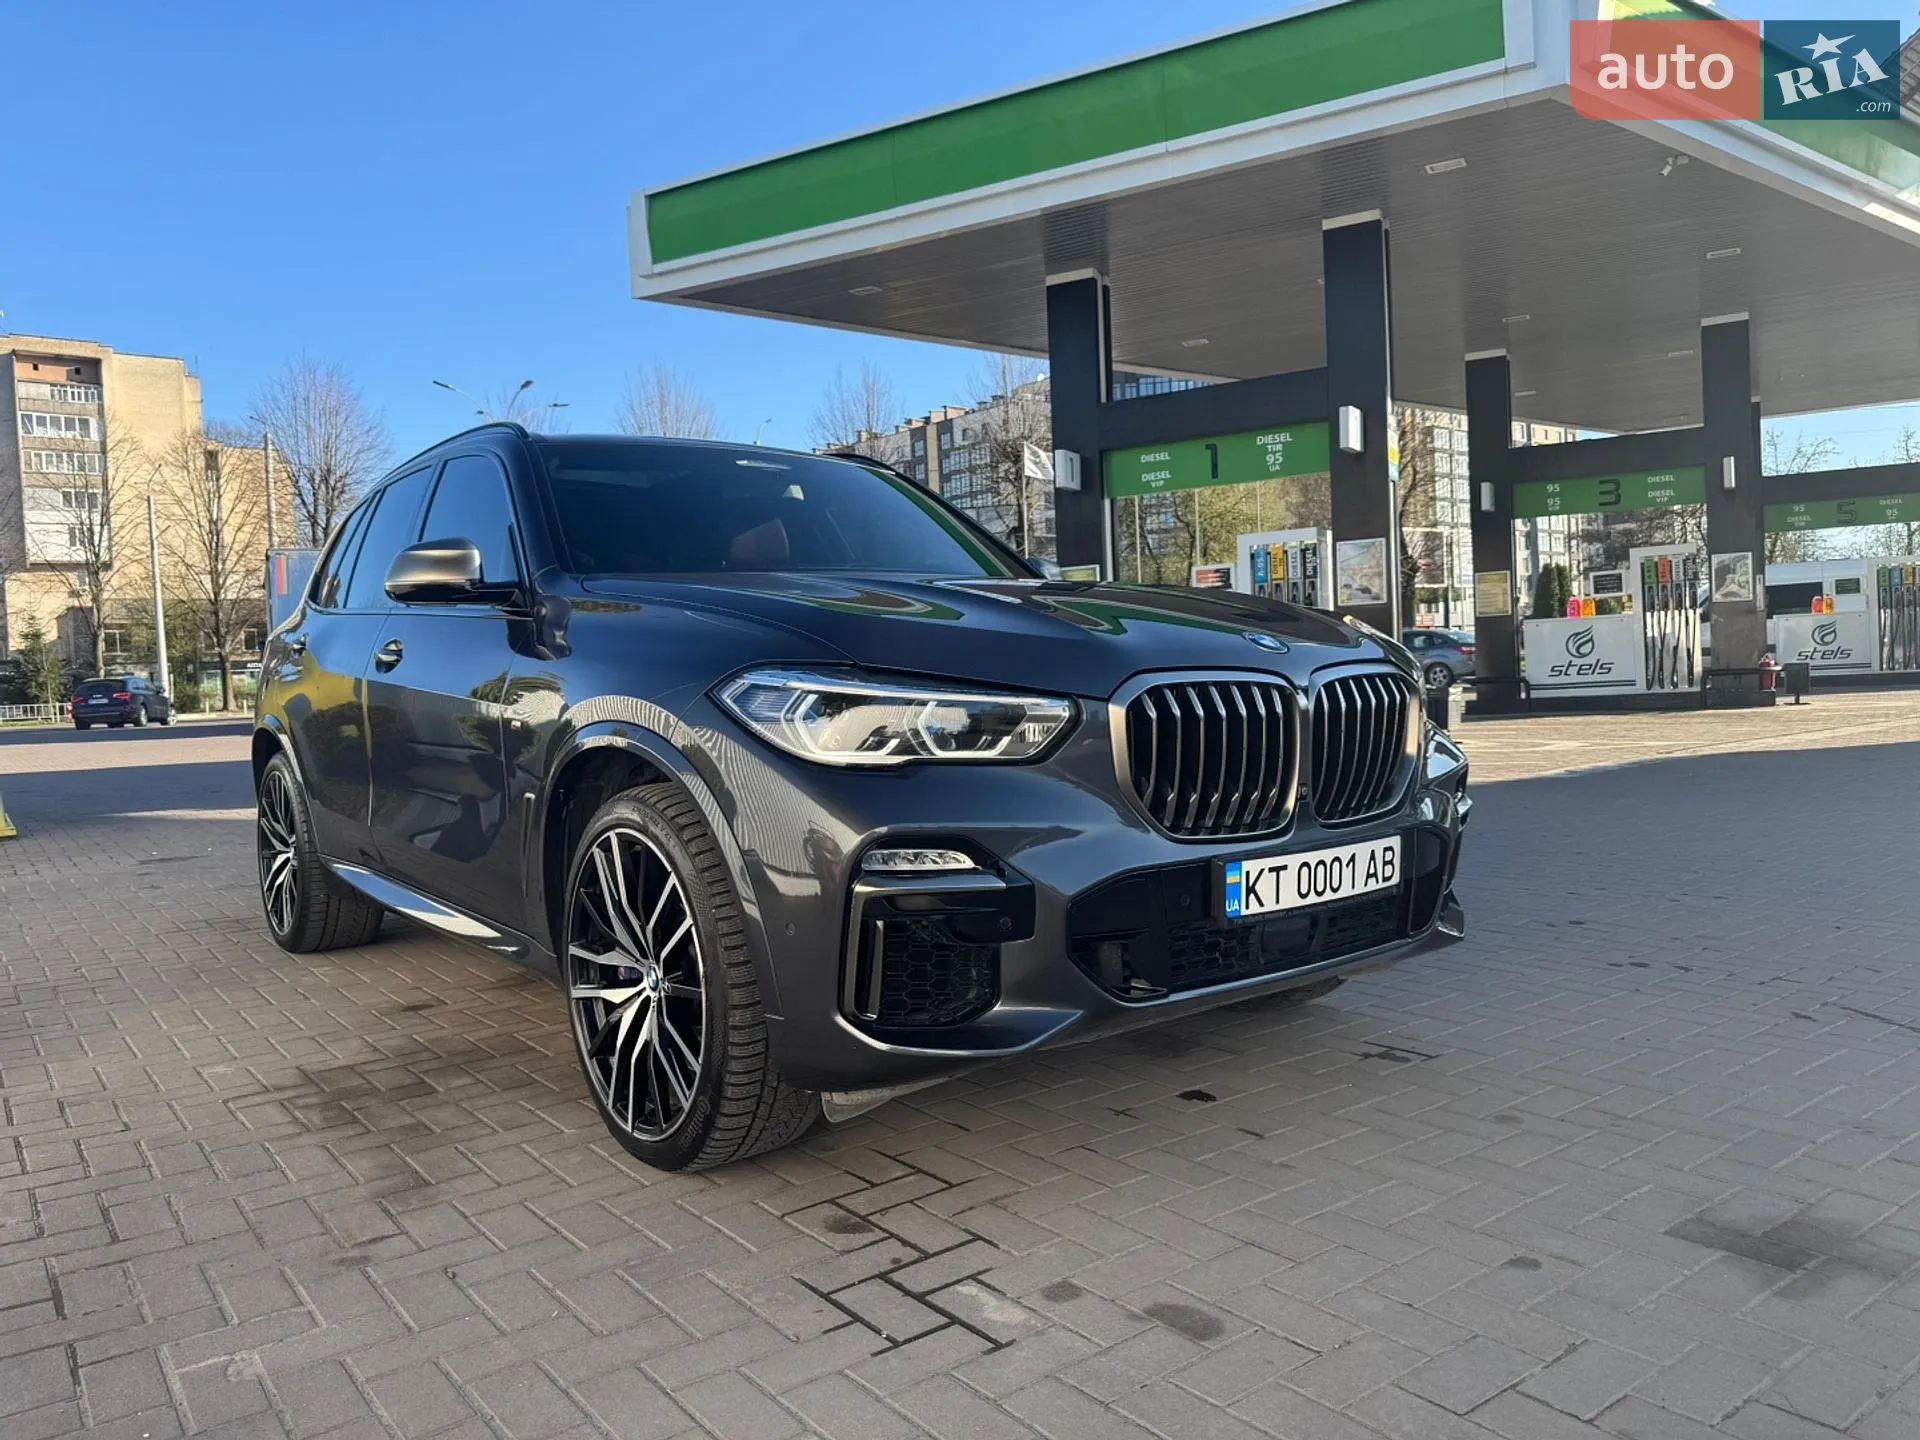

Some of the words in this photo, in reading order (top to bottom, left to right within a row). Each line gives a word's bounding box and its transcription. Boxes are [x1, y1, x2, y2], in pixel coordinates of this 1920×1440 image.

[1256, 432, 1293, 445] DIESEL
[1266, 444, 1283, 453] TIR
[1141, 452, 1171, 463] DIESEL
[1205, 443, 1219, 479] 1
[1266, 452, 1283, 465] 95
[1141, 470, 1172, 482] DIESEL
[1648, 474, 1676, 483] DIESEL
[1546, 483, 1560, 493] 95
[1598, 479, 1621, 507] 3
[1648, 489, 1676, 498] DIESEL
[1546, 497, 1560, 506] 95
[1793, 504, 1805, 512] 95
[1837, 501, 1856, 524] 5
[1886, 508, 1899, 516] 95
[1796, 646, 1853, 661] stels
[1548, 658, 1614, 677] stels
[1244, 864, 1288, 910] KT
[1297, 852, 1357, 900] 0001
[1364, 846, 1395, 888] AB
[1225, 899, 1240, 912] UA
